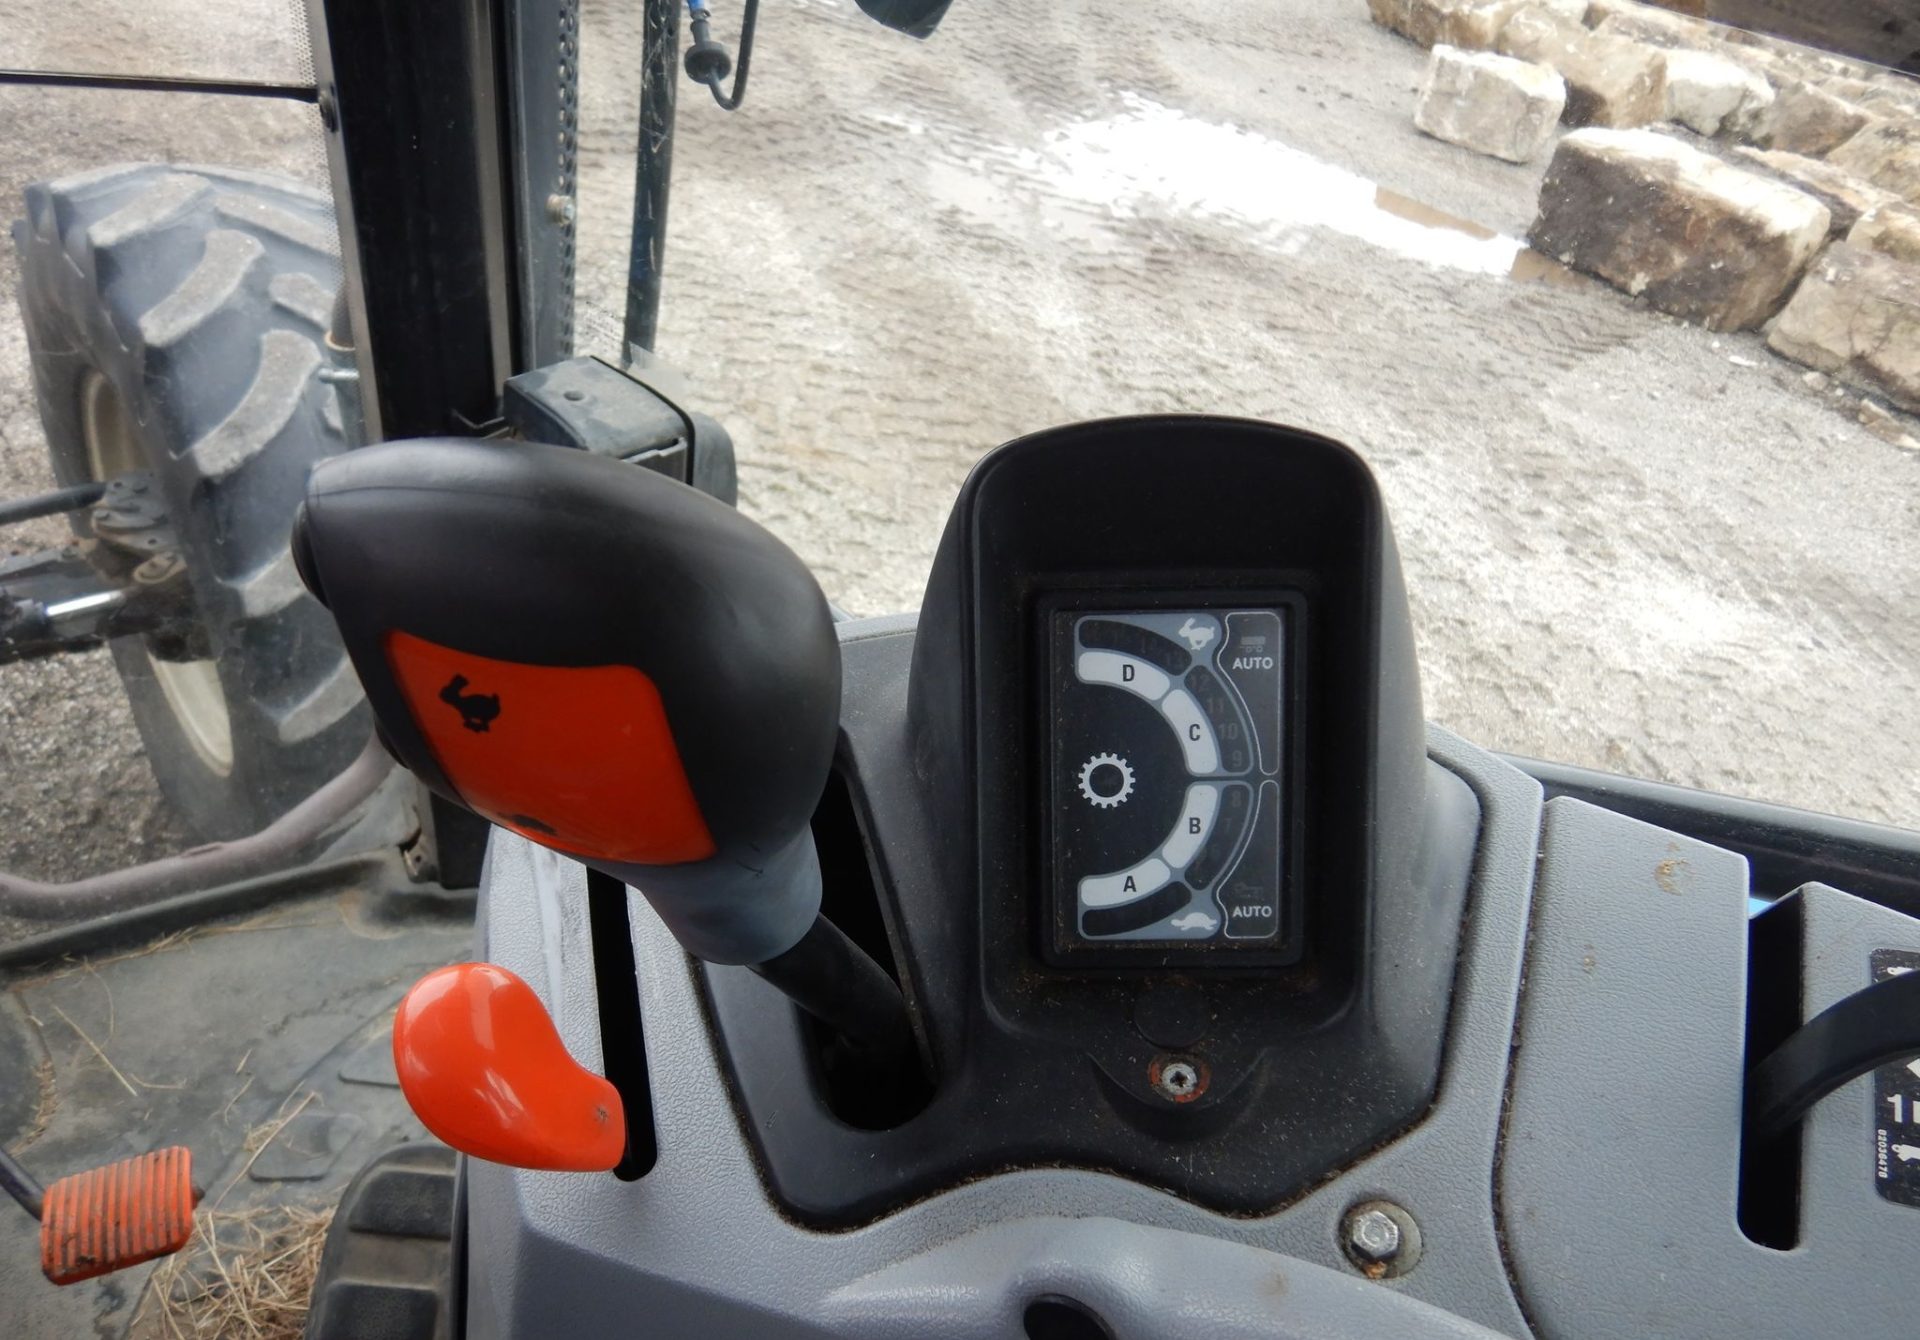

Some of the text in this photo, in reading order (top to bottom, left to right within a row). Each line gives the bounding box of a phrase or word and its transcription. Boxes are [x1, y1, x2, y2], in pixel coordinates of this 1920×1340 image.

[1232, 656, 1273, 670] AUTO
[1122, 664, 1135, 682] D
[1189, 723, 1201, 742] C
[1218, 722, 1239, 740] 10
[1231, 749, 1243, 767] 9
[1231, 790, 1242, 808] 8
[1189, 817, 1201, 834] B
[1123, 876, 1137, 893] A
[1232, 906, 1273, 919] AUTO
